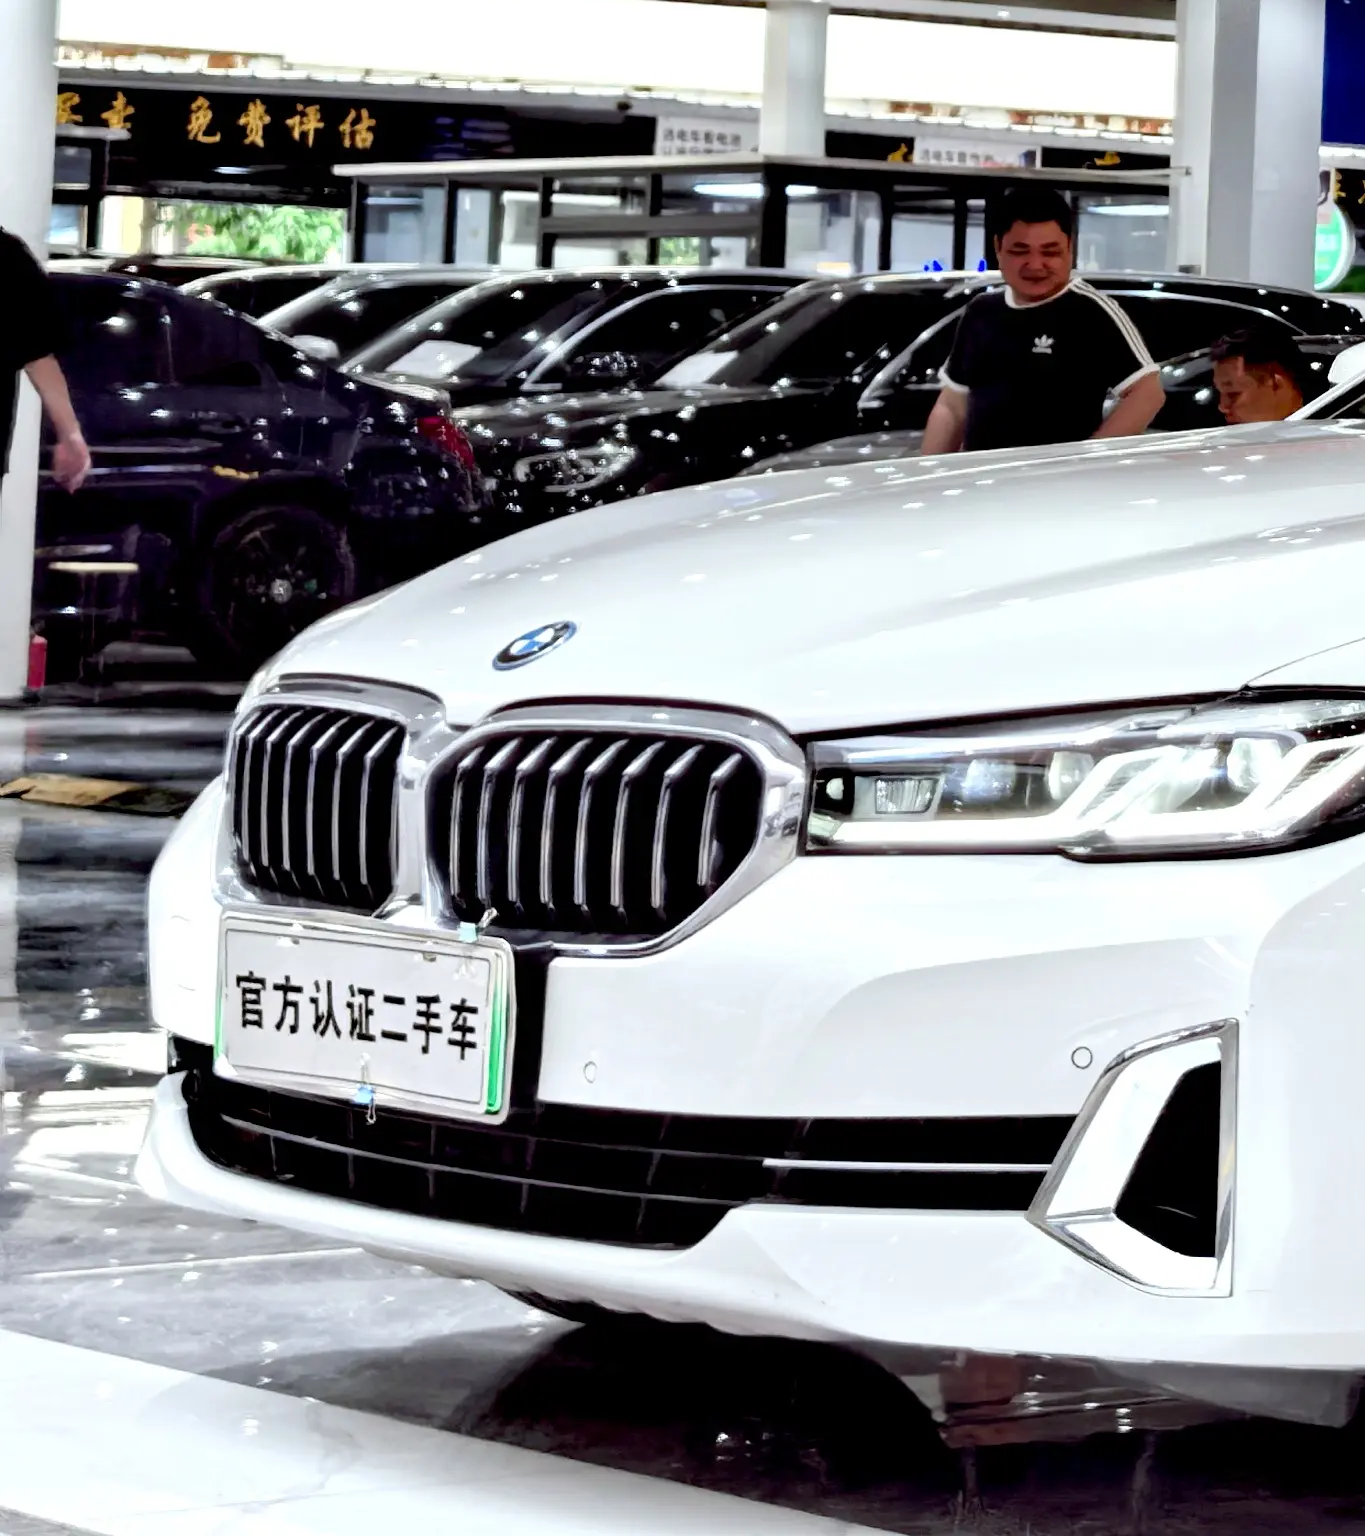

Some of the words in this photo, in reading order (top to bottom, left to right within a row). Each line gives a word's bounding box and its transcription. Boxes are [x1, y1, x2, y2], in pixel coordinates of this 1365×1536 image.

[187, 96, 376, 149] 免费评估
[236, 970, 479, 1061] 官方认证二手车
